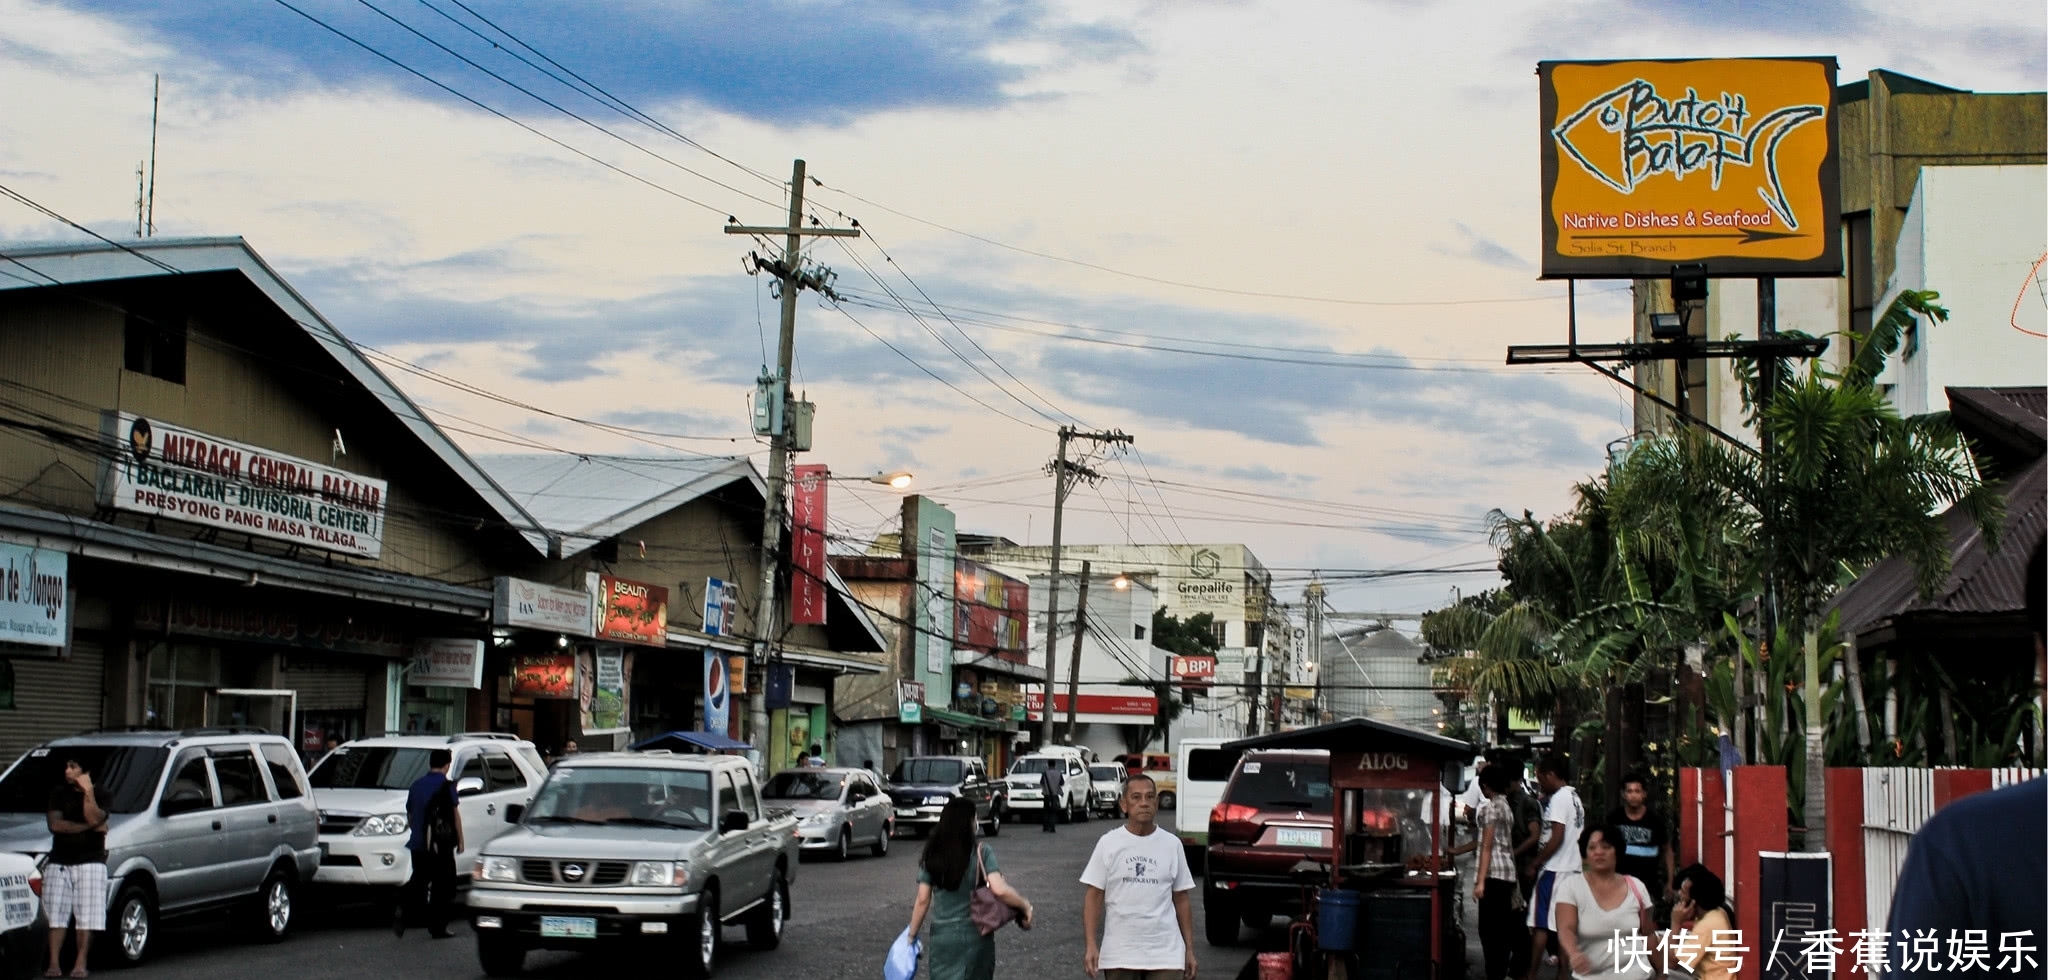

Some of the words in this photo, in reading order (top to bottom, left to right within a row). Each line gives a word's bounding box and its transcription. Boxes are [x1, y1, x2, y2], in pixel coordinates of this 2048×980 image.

[1563, 212, 1619, 230] Native
[1624, 211, 1679, 229] Dishes
[1684, 211, 1697, 227] &
[1701, 209, 1772, 228] Seafood
[1570, 241, 1603, 254] Solis
[1630, 240, 1677, 254] Branch
[162, 432, 242, 482] MIZRACH
[248, 455, 316, 499] CENTRAL
[321, 473, 381, 514] BAZAAR
[133, 488, 220, 521] PRESYONG
[224, 509, 264, 530] PANG
[267, 518, 306, 538] MASA
[239, 491, 313, 523] DIVISORIA
[7, 557, 19, 602] de
[1177, 581, 1233, 595] Grepalife
[615, 581, 648, 598] BEAUTY
[1189, 661, 1211, 673] BPI
[1357, 752, 1409, 770] ALOG
